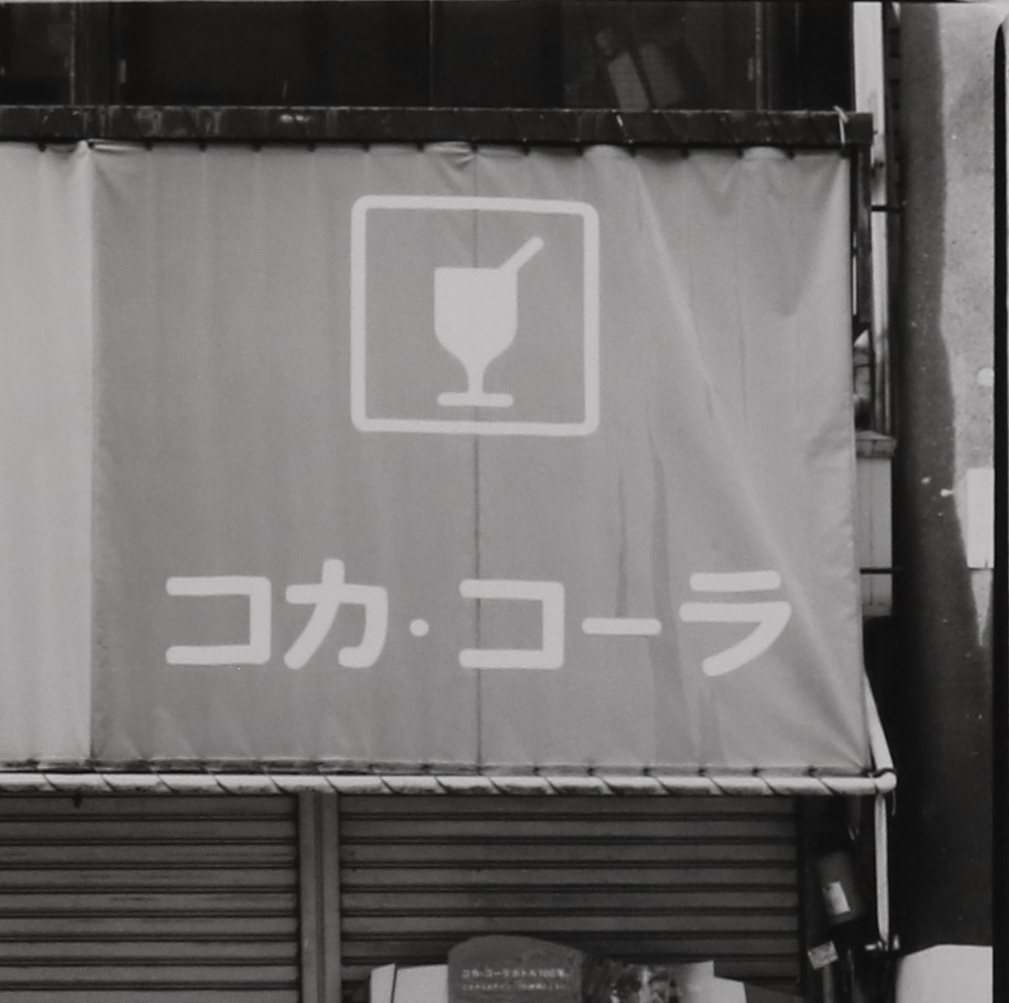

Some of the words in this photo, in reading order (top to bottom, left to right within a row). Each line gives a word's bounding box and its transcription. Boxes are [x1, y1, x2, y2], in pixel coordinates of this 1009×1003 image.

[165, 558, 792, 676] コカ・コーラ
